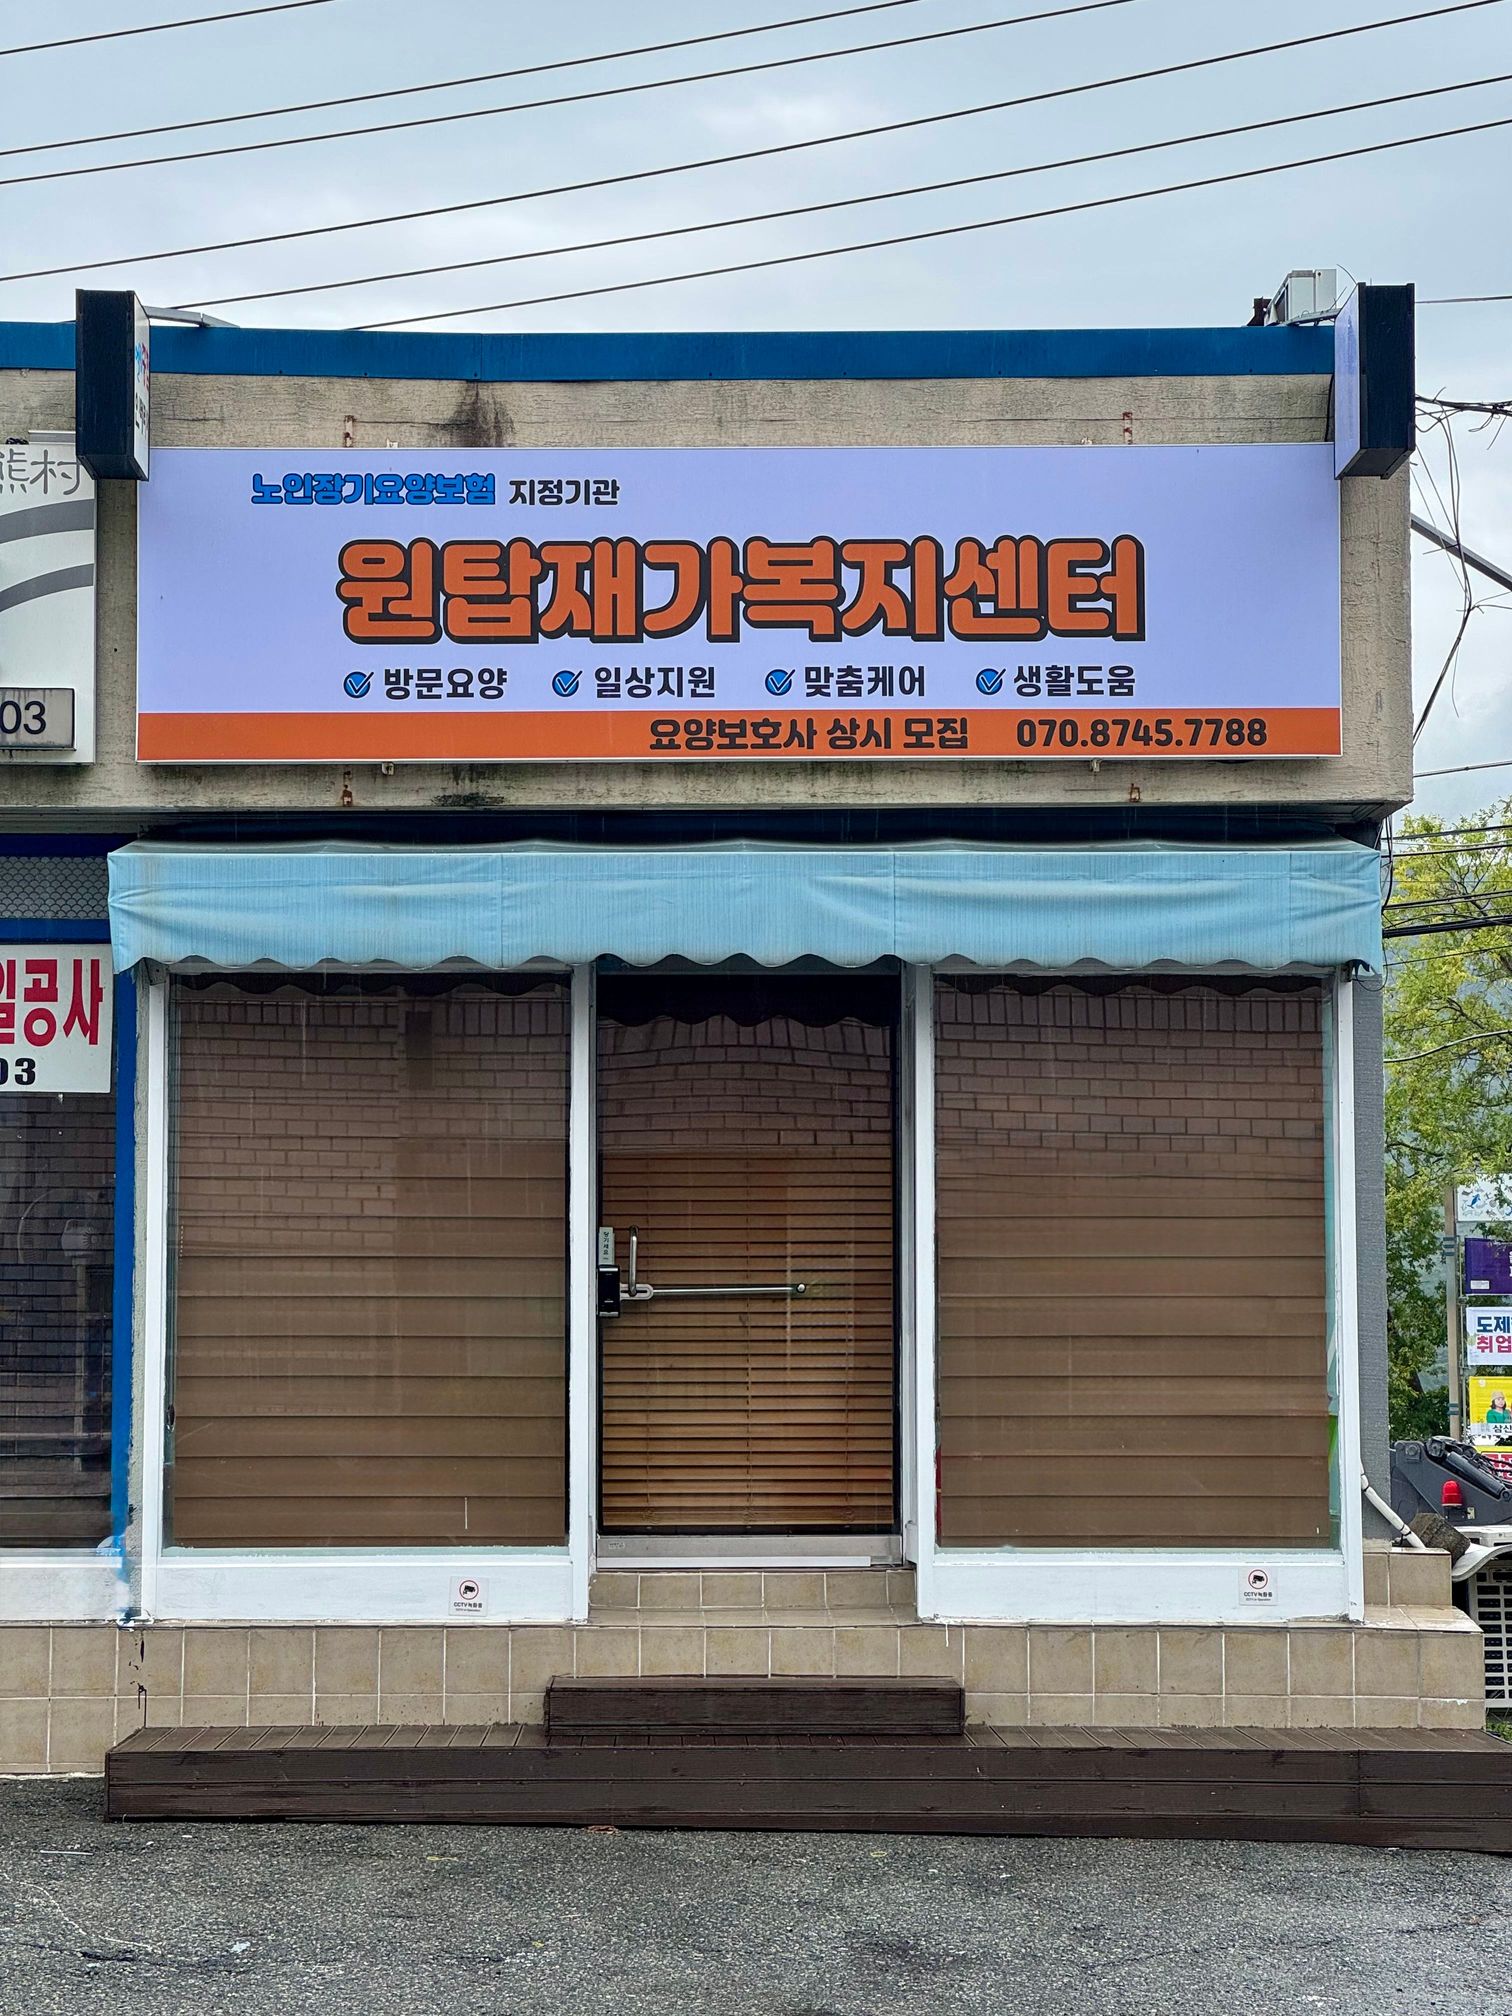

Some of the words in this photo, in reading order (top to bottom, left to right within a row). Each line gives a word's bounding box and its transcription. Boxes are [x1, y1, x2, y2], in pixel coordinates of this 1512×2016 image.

[251, 473, 496, 506] 노인장기요양보험
[509, 479, 621, 506] 지정기관
[336, 534, 1146, 645] 원탑재가복지센터
[384, 668, 508, 700] 방문요양
[594, 667, 715, 699] 일상지원
[804, 665, 926, 698] 맞춤케어
[1013, 665, 1136, 698] 생활도움
[0, 700, 47, 735] 03
[650, 718, 818, 751] 요양보호사
[827, 717, 892, 750] 상시
[902, 716, 968, 750] 모집
[1017, 717, 1268, 750] 070.8745.7788
[1476, 1316, 1512, 1334] 도제
[1476, 1335, 1512, 1353] 취업
